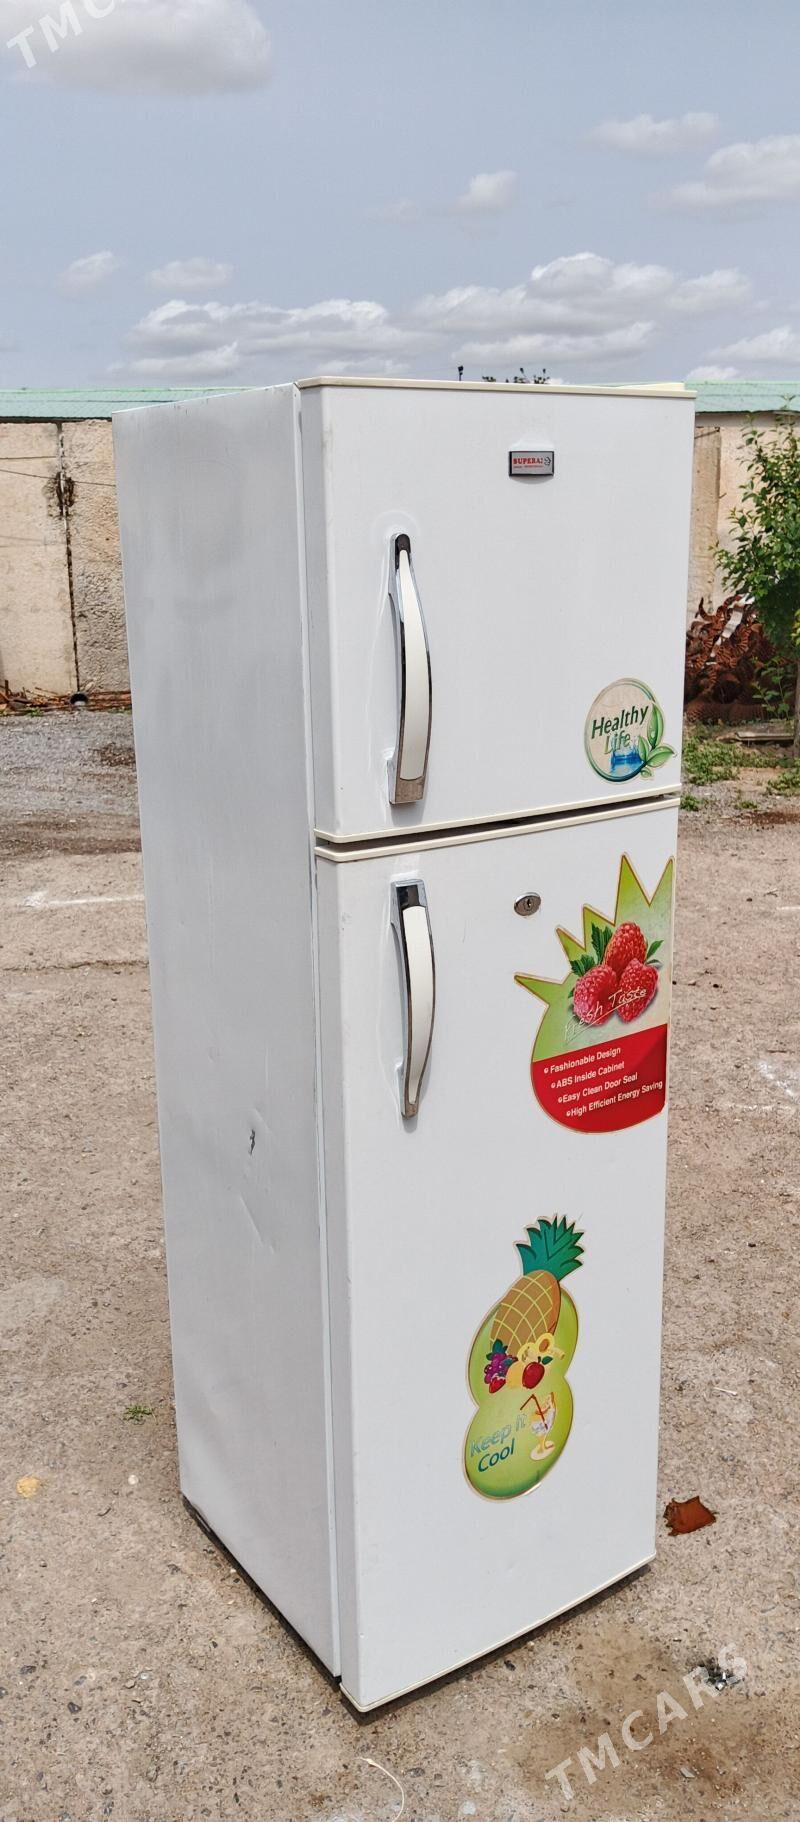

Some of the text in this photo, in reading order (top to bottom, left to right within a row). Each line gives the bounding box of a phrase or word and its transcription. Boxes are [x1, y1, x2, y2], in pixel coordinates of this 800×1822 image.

[591, 705, 649, 740] Healthy
[604, 730, 631, 755] Life
[608, 986, 647, 1008] Taste
[550, 1047, 621, 1074] Fashionable Design
[555, 1061, 625, 1089] ABS Inside Cabinet
[562, 1072, 638, 1103] Easy Clean Door Seal
[570, 1080, 663, 1117] High Efficient Energy Saving
[470, 1424, 513, 1458] Keep
[478, 1438, 515, 1473] Cool
